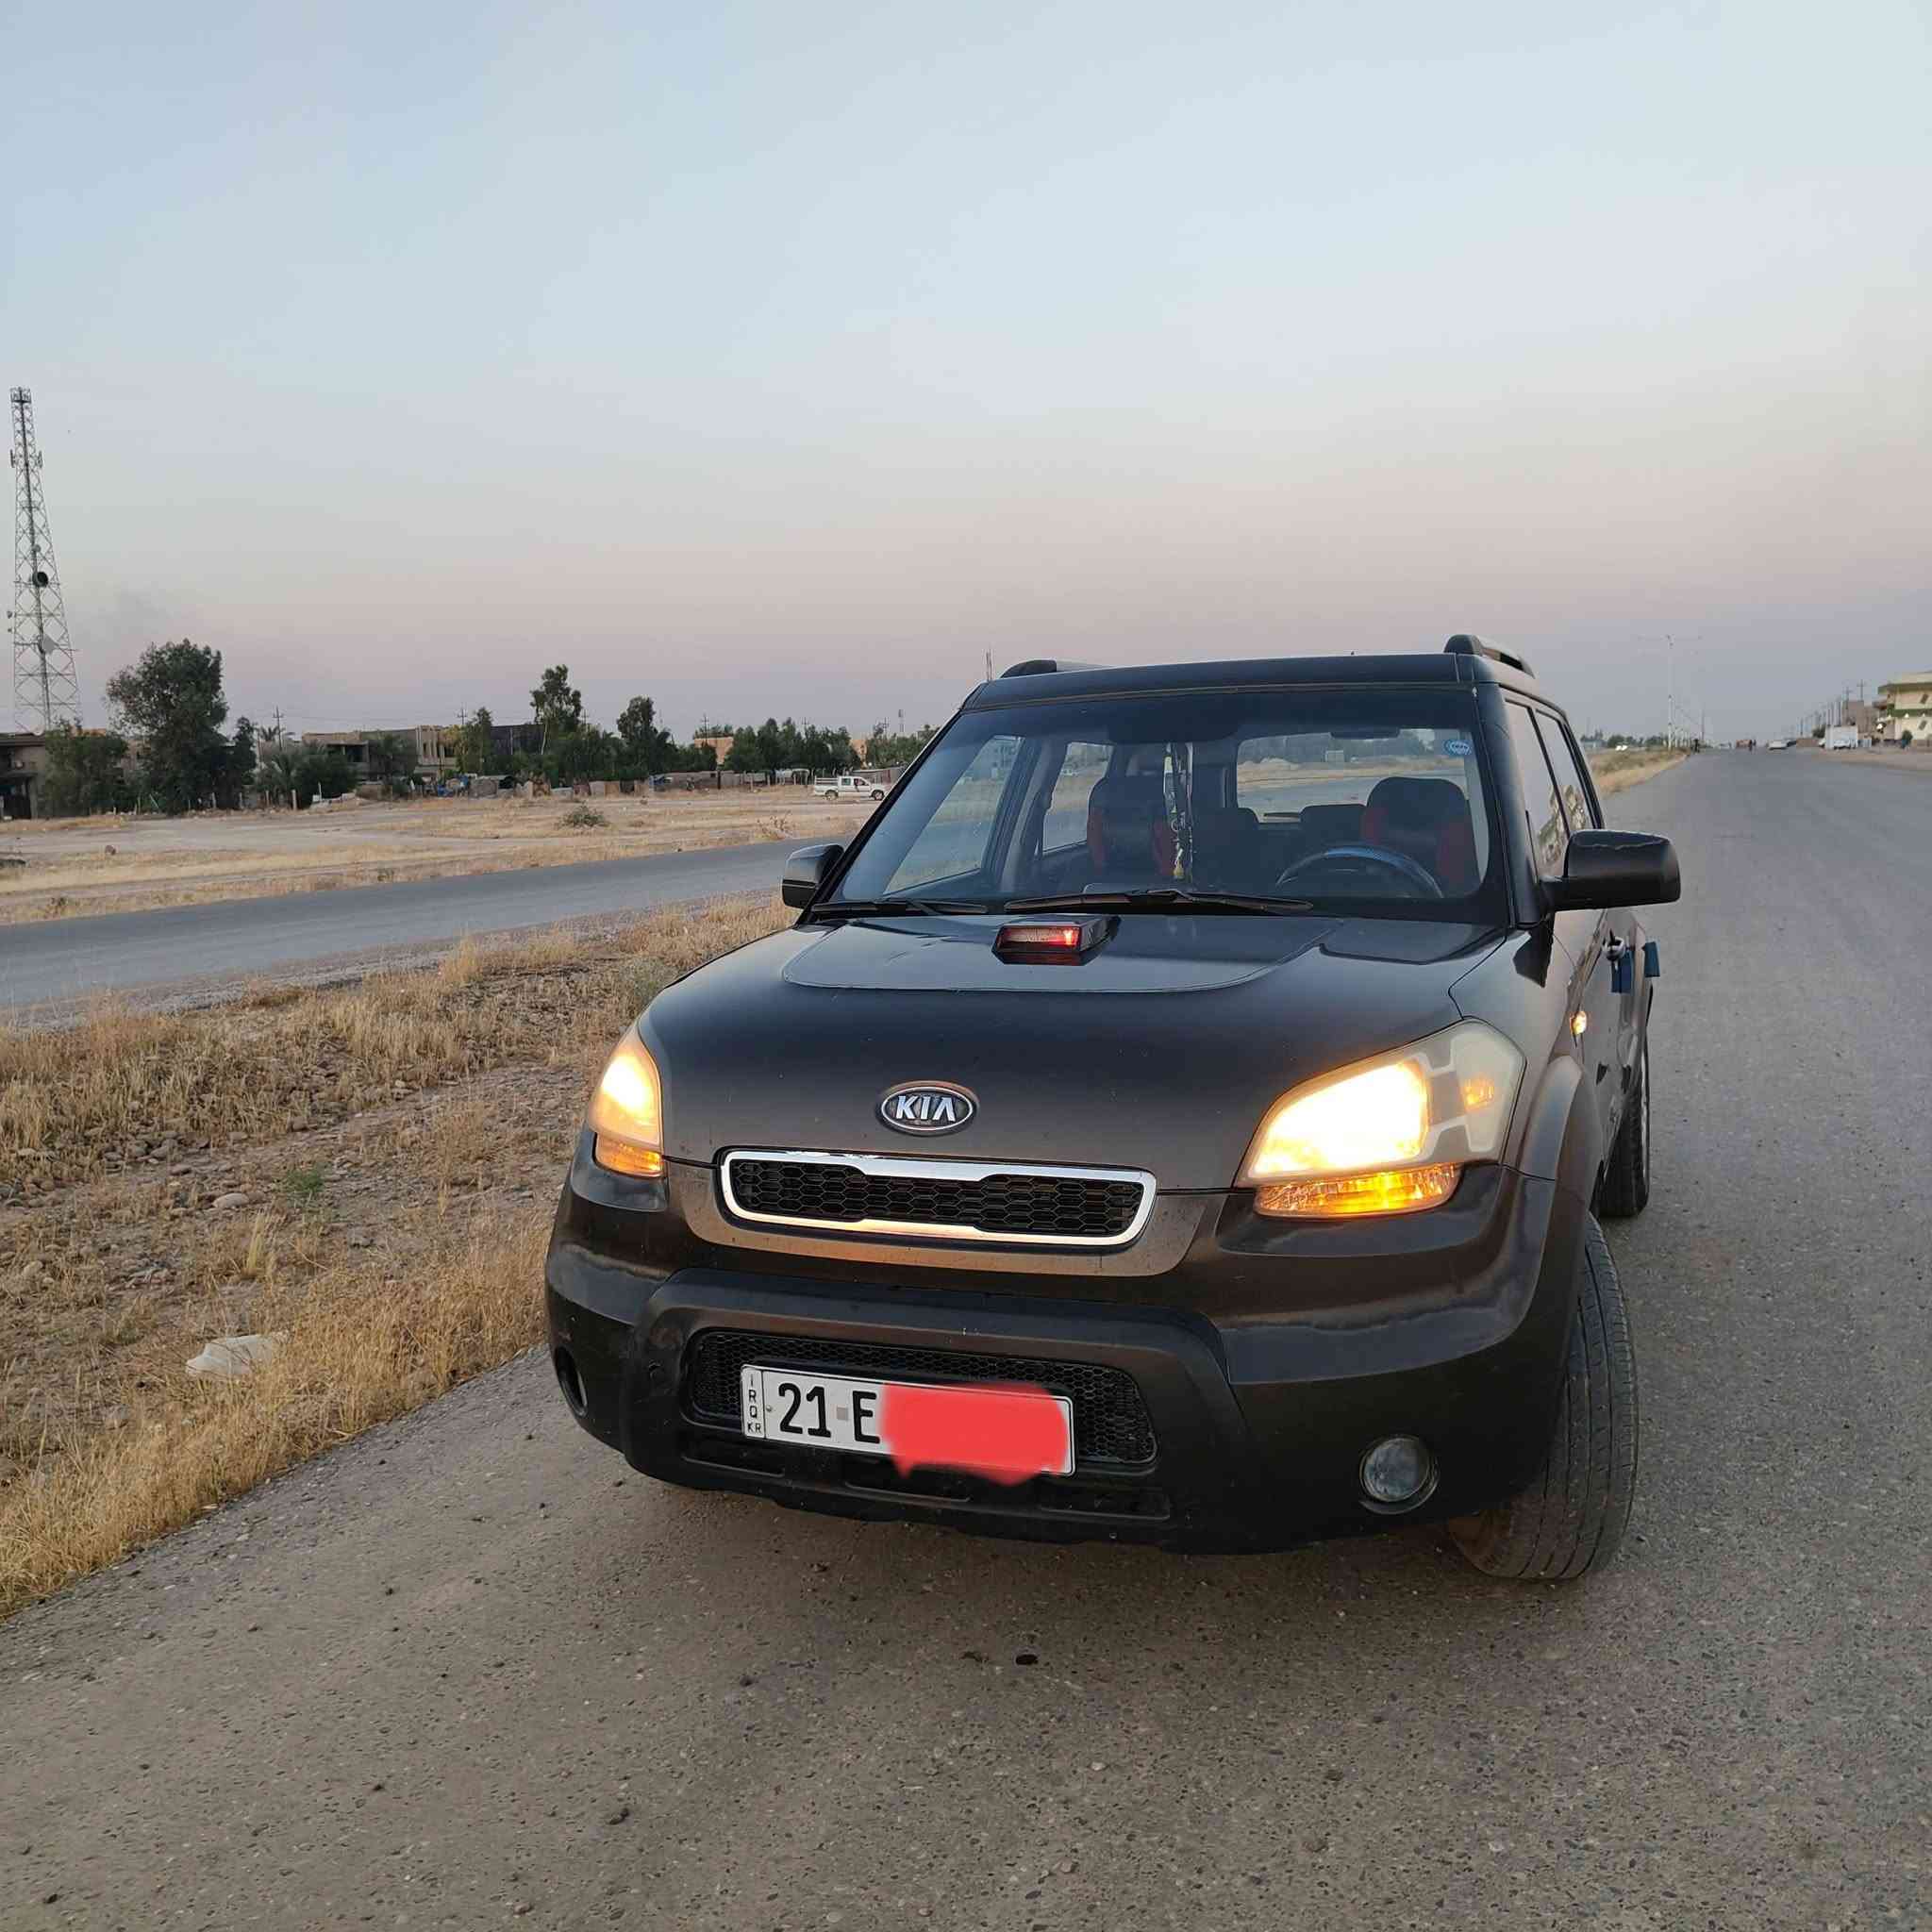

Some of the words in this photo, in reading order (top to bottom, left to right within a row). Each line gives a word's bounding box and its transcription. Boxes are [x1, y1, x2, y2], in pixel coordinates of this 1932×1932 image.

[895, 1094, 957, 1123] KIA
[746, 1421, 762, 1434] KR
[777, 1382, 832, 1439] 21
[852, 1390, 881, 1444] E
